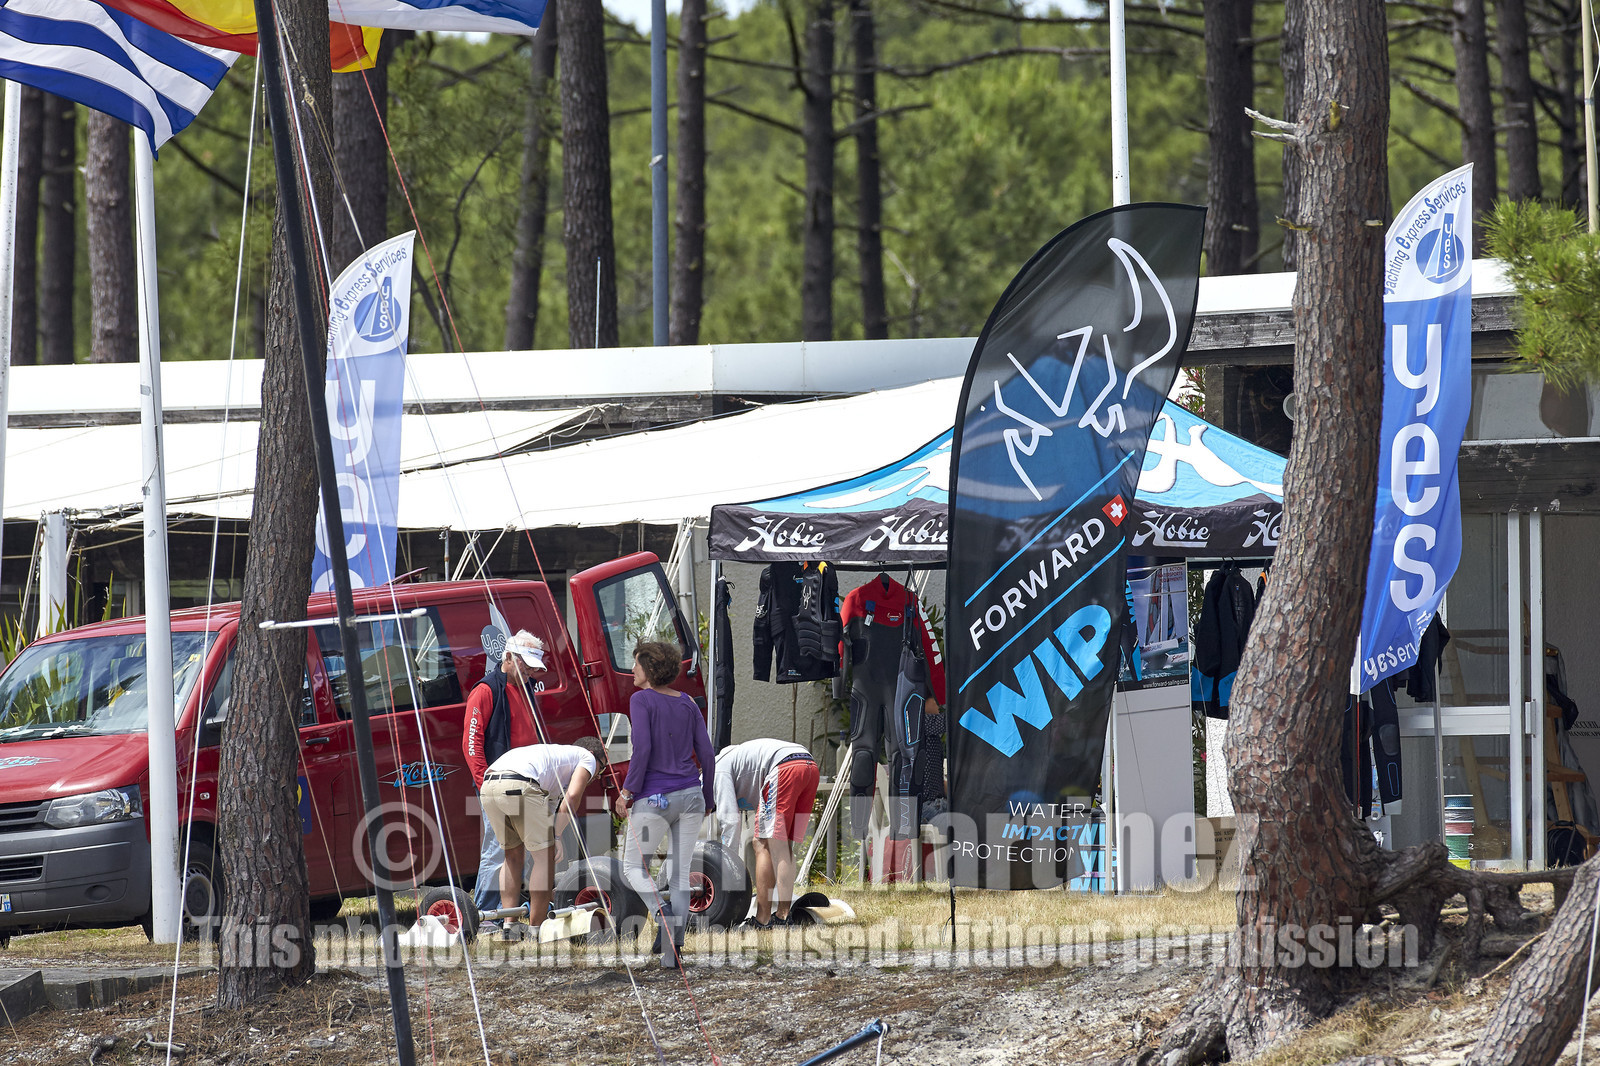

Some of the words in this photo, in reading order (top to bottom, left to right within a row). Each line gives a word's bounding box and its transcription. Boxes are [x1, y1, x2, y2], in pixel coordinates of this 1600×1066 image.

[1424, 181, 1467, 214] Services
[364, 247, 408, 278] Services
[1443, 223, 1454, 269] yes
[1390, 324, 1442, 612] yes
[734, 516, 826, 553] Hobie
[1131, 511, 1210, 548] Hobie
[969, 518, 1105, 651] FORWARD
[959, 605, 1111, 758] WIP
[469, 717, 478, 757] GLÉNANS
[393, 761, 446, 788] Hobie
[1009, 801, 1085, 819] WATER
[1002, 823, 1083, 841] IMPACT
